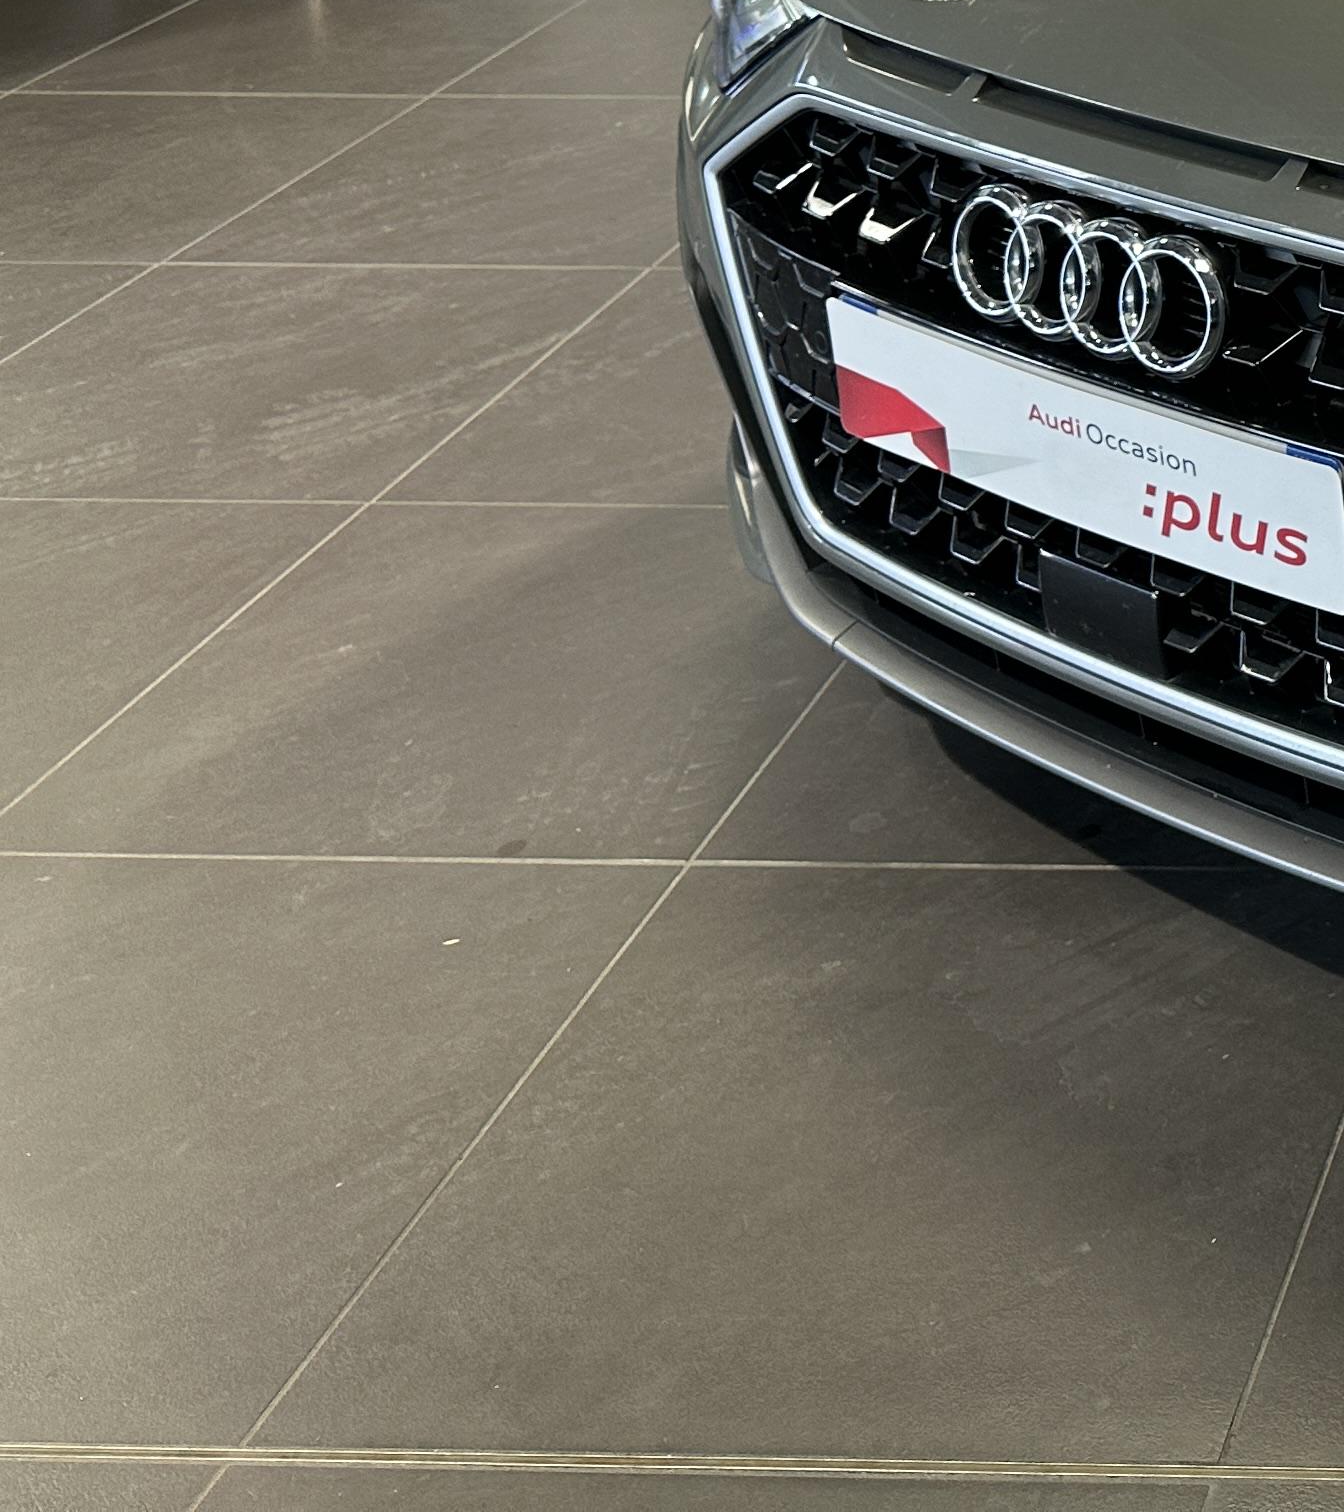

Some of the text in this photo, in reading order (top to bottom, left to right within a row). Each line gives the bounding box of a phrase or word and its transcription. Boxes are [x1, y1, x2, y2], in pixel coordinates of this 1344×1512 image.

[1028, 404, 1198, 477] Audi Occasion
[1142, 483, 1308, 566] :plus
